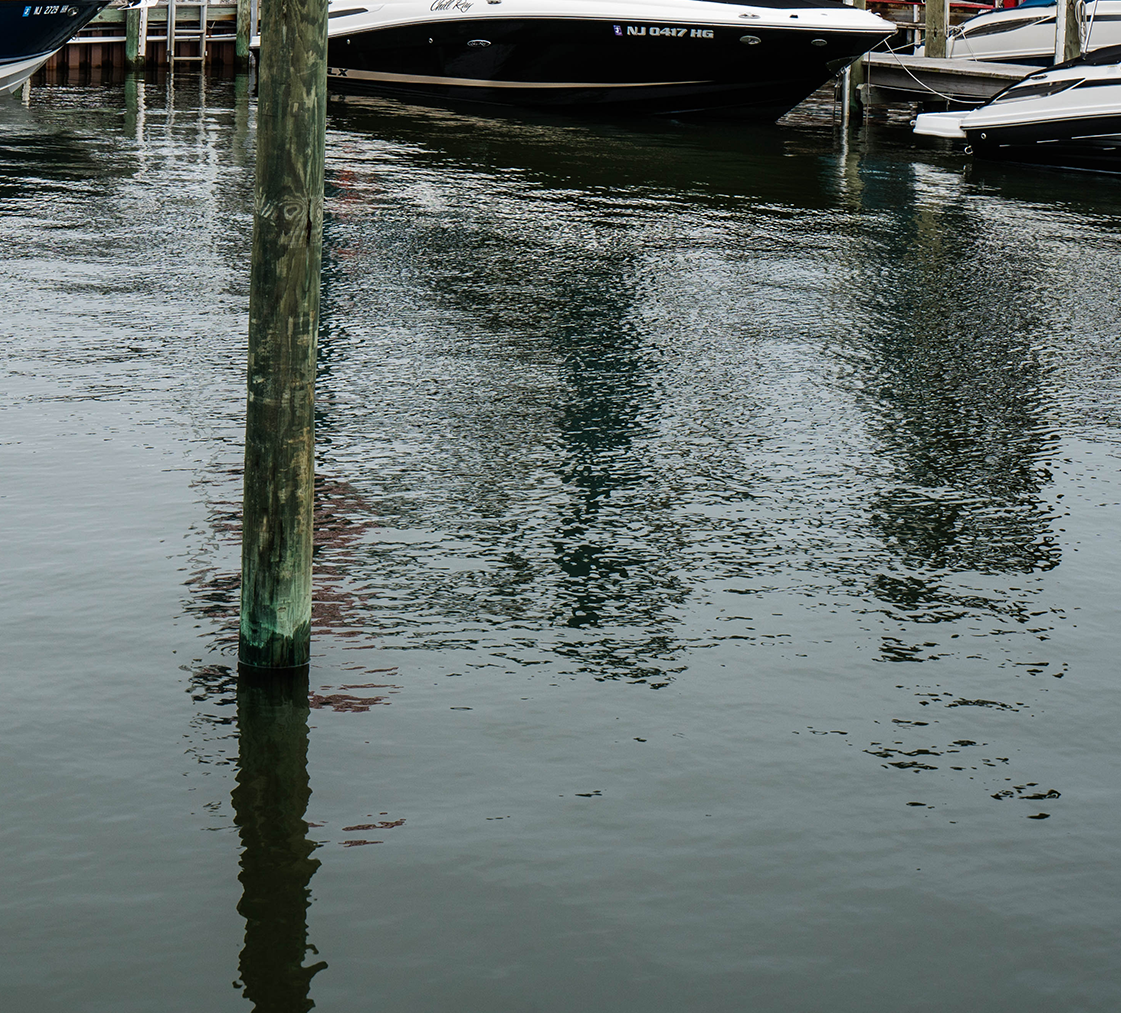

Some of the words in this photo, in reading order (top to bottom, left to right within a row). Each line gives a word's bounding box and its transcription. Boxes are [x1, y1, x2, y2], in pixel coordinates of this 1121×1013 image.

[33, 6, 43, 15] NJ
[627, 26, 646, 36] NJ
[649, 27, 688, 38] 0417
[690, 29, 714, 38] HG
[327, 68, 348, 77] LX
